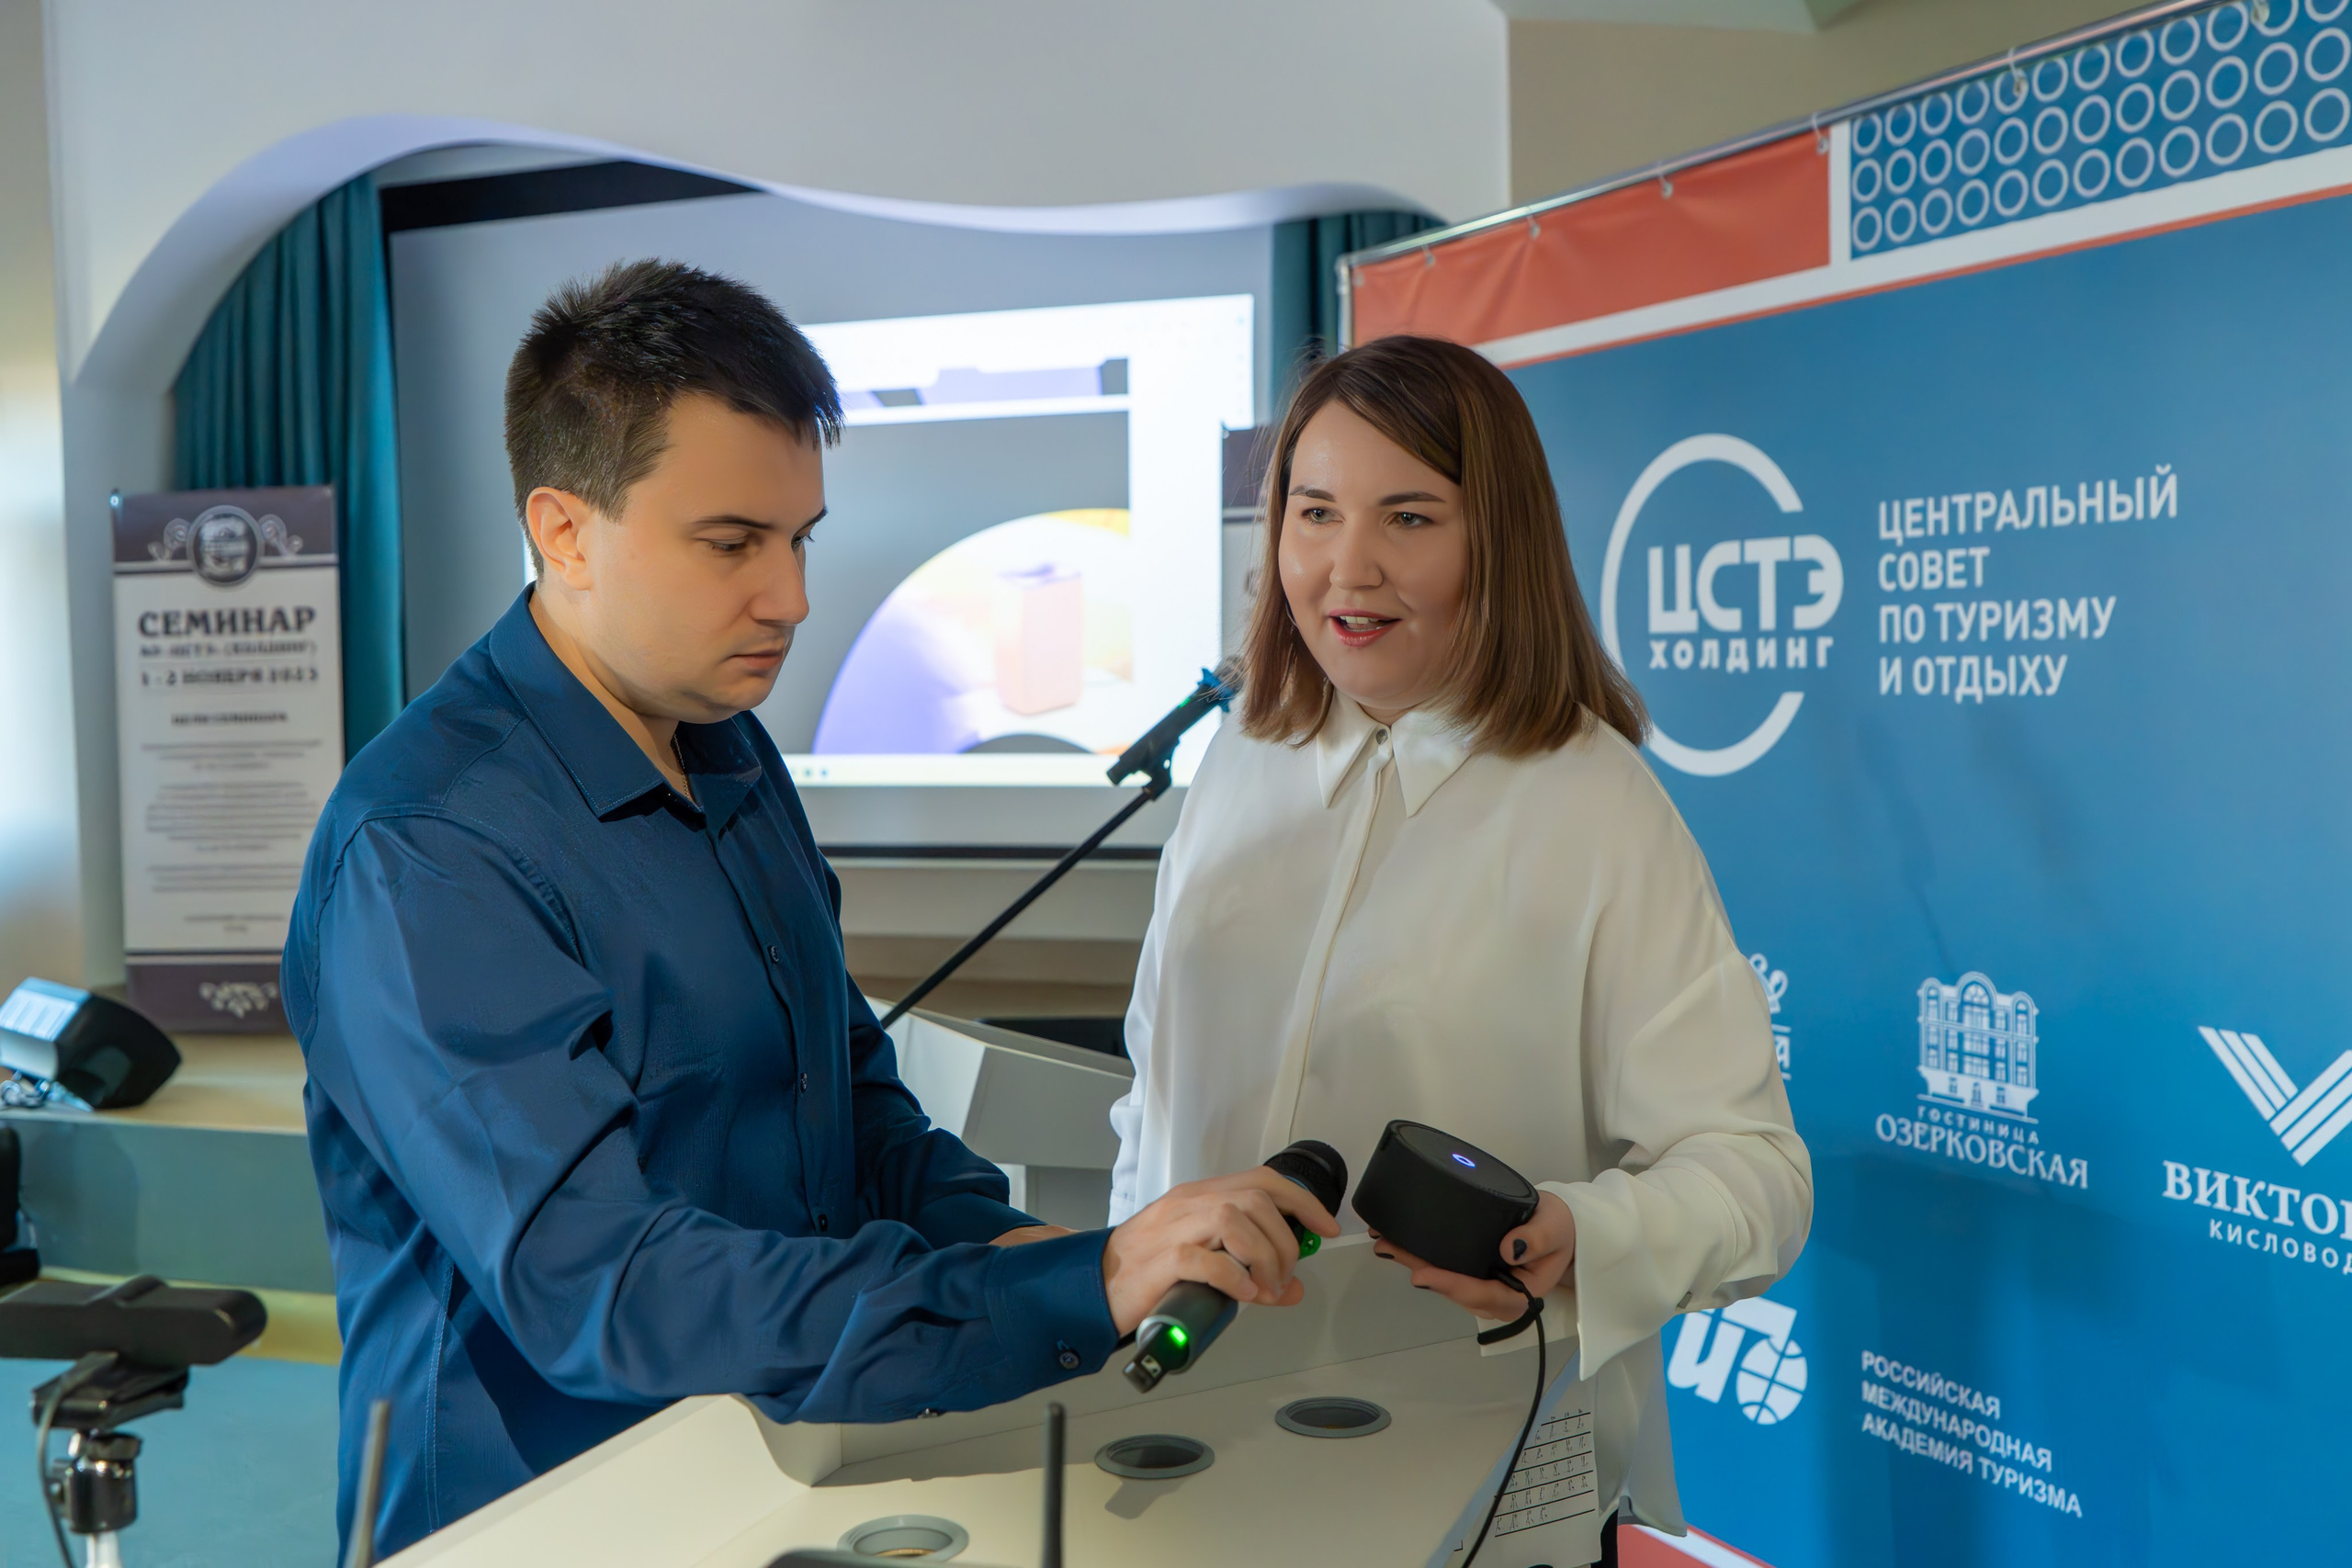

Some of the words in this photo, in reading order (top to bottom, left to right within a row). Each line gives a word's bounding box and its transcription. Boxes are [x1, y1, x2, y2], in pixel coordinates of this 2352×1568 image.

[1879, 463, 2177, 547] ЦЕНТРАЛЬНЫЙ
[1648, 534, 1844, 634] ЦСТЭ
[1878, 546, 1991, 592] СОВЕТ
[138, 605, 316, 637] СЕМИНАР
[1880, 604, 1927, 644] ПО
[1933, 595, 2117, 643] ТУРИЗМУ
[1648, 636, 1835, 673] ХОЛДИНГ
[1880, 656, 1903, 696] И
[1912, 654, 2068, 705] ОТДЫХУ
[1875, 1112, 2089, 1190] ОЗЕРКОВСКАЯ
[1917, 1105, 2040, 1145] ГОСТИНИЦА
[1861, 1350, 2000, 1420] РОССИЙСКАЯ
[1861, 1380, 2052, 1472] МЕЖДУНАРОДНАЯ
[1861, 1412, 1973, 1475] АКАДЕМИЯ
[1978, 1456, 2083, 1518] ТУРИЗМА
